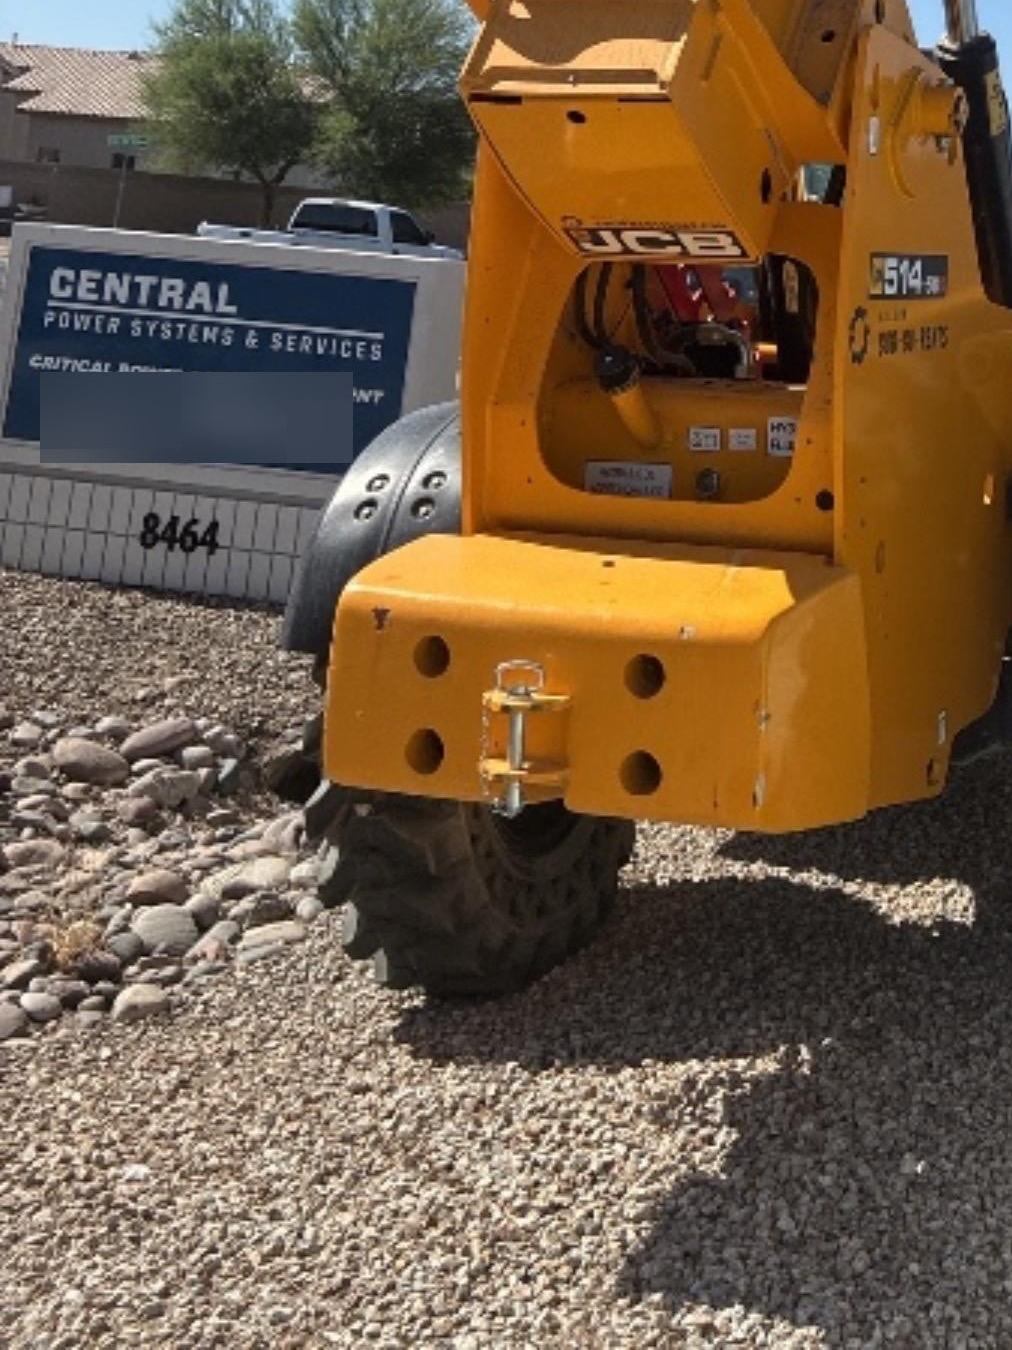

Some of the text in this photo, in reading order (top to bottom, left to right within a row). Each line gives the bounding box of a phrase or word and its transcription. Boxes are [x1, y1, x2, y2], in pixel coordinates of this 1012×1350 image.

[579, 230, 743, 257] JCB
[50, 266, 238, 314] CENTRAL
[44, 311, 382, 362] POWER SYSTEMS & SERVICES
[140, 513, 219, 556] 8464
